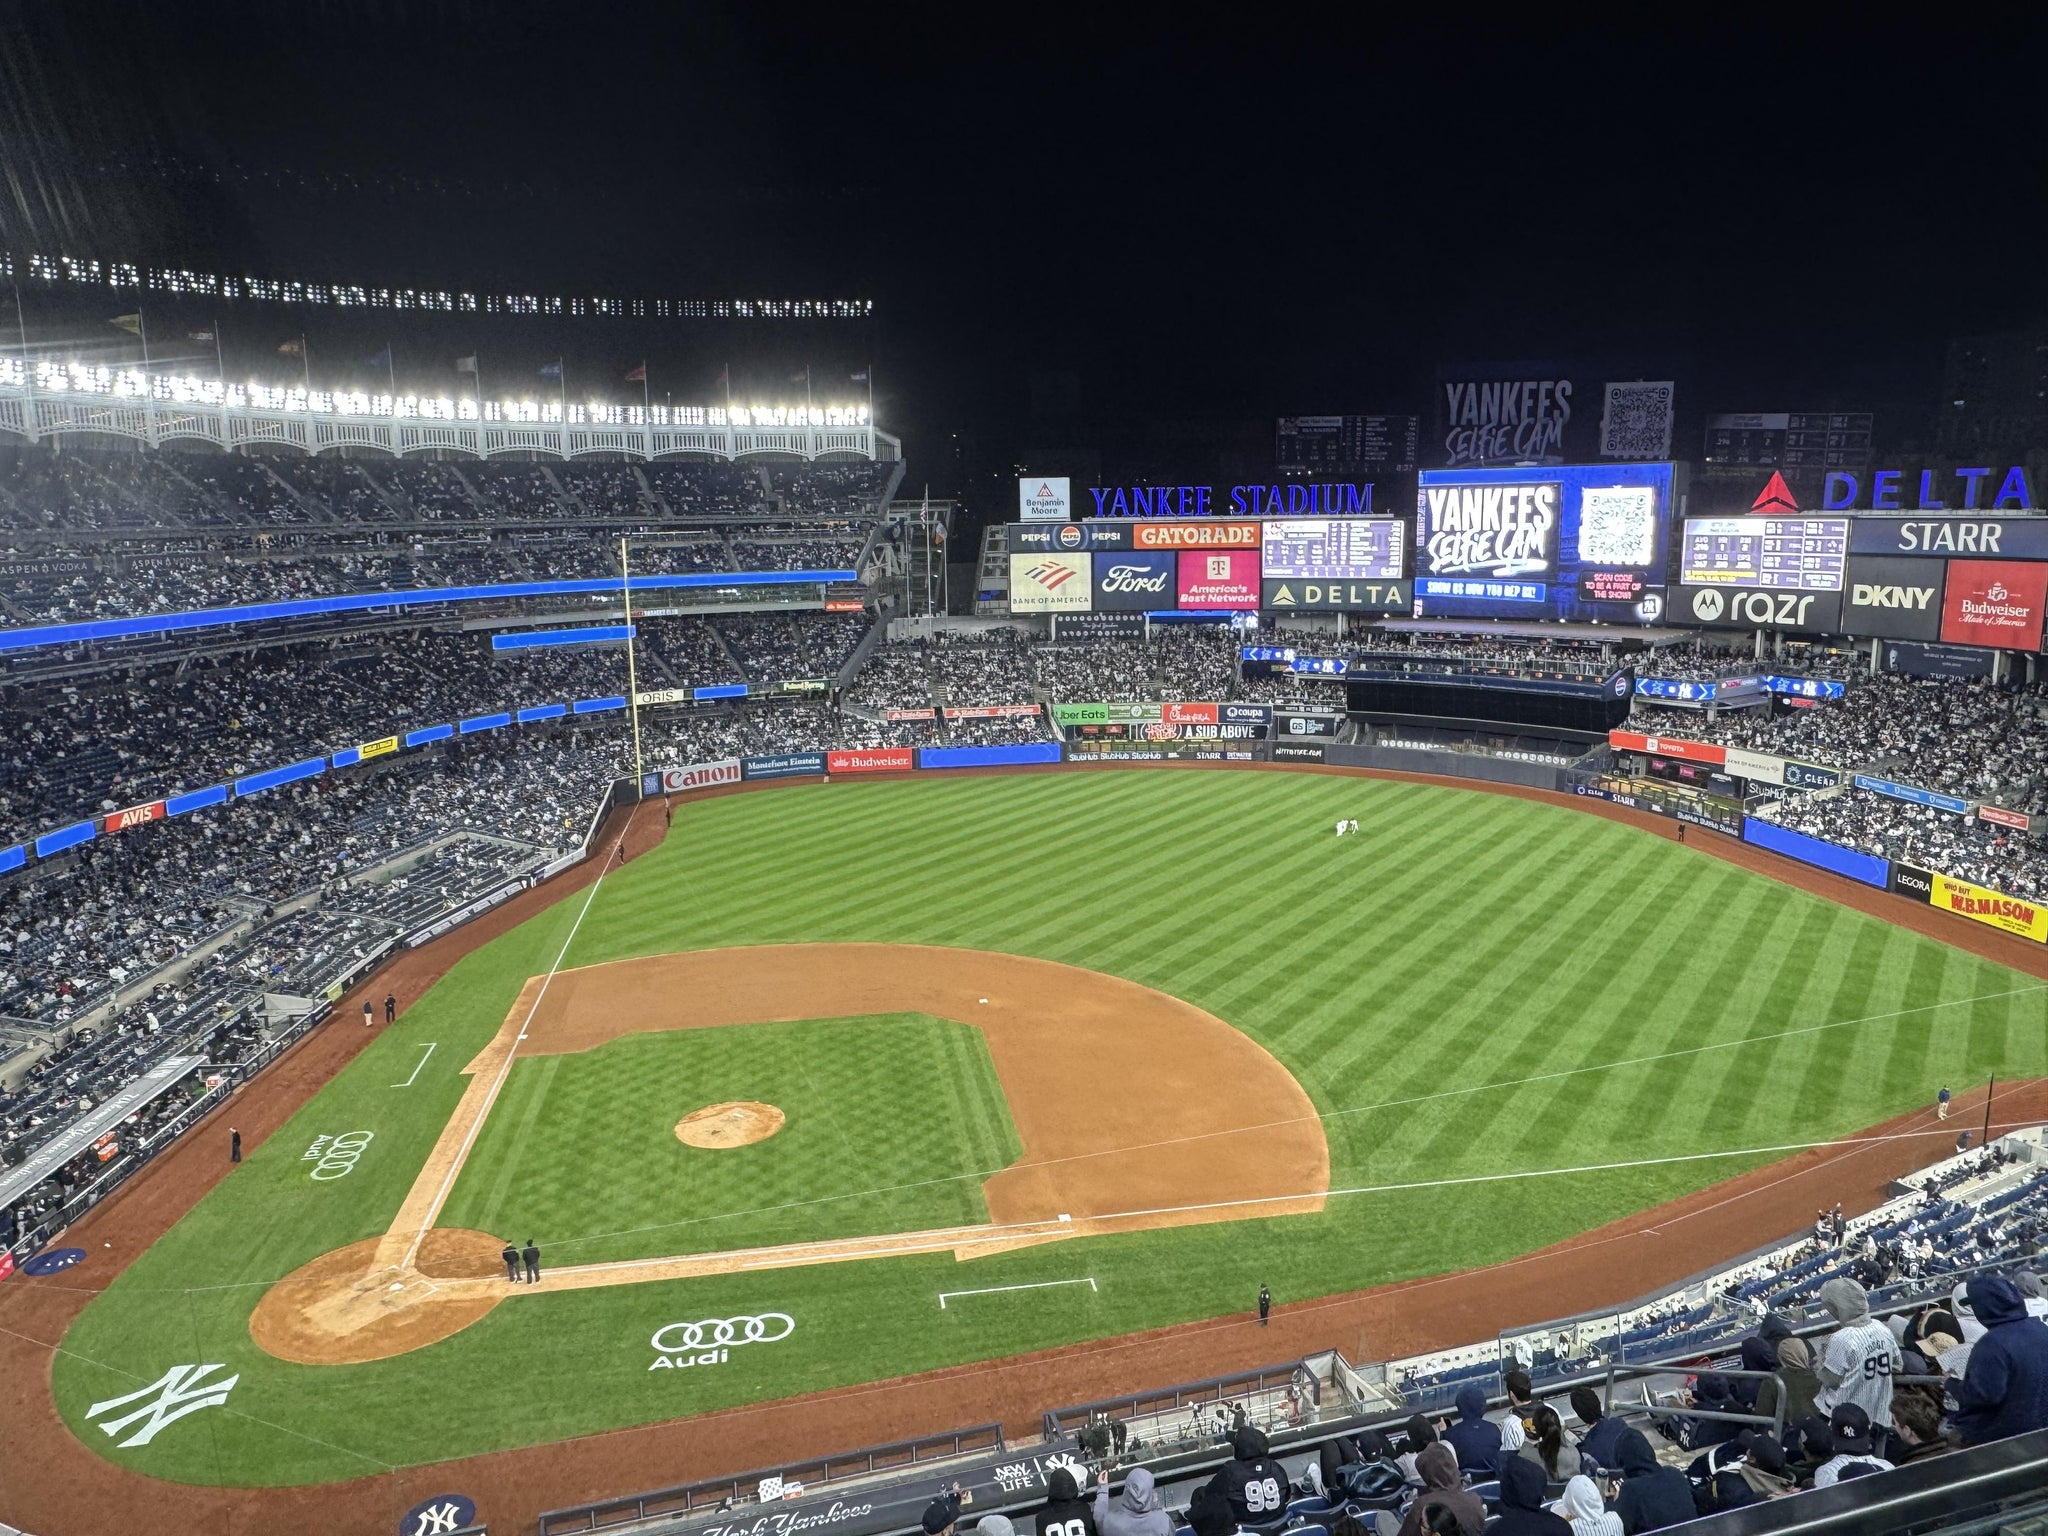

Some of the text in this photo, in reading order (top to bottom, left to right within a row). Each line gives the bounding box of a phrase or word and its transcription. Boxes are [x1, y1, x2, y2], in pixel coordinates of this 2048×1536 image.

[1446, 380, 1572, 425] YANKEES
[1822, 466, 2031, 511] DELTA
[1026, 498, 1065, 508] Benjamin
[1089, 483, 1375, 517] YANKEE STADIUM
[1427, 486, 1553, 531] YANKEES
[1021, 533, 1051, 542] PEPSI
[1092, 532, 1121, 541] PEPSI
[1141, 527, 1255, 544] GATORADE
[1898, 522, 2002, 552] STARR
[0, 562, 88, 575] ASPEN VODKA
[132, 559, 163, 568] ASPEN
[1101, 565, 1168, 592] Ford
[1594, 574, 1633, 582] SCAN CODE
[1189, 584, 1248, 594] America's
[1486, 584, 1502, 596] YOU
[1631, 583, 1642, 591] OF
[1050, 596, 1089, 604] AMERICA
[1180, 593, 1258, 603] Best Network
[1305, 585, 1403, 604] DELTA
[1594, 590, 1607, 598] THE
[1852, 584, 1935, 609] DKNY
[1731, 592, 1815, 625] razr
[1961, 599, 2029, 617] Budweiser
[1985, 616, 1994, 626] of
[642, 691, 674, 703] ORIS
[1082, 710, 1105, 719] Eats
[1238, 709, 1263, 718] coupa
[1186, 725, 1193, 738] A
[1196, 725, 1218, 738] SUB
[1220, 725, 1255, 738] ABOVE
[1659, 743, 1684, 752] TOYOTA
[851, 756, 909, 768] Budweiser
[1069, 753, 1098, 761] StubHub
[1100, 752, 1129, 760] StubHub
[1131, 752, 1161, 760] StubHub
[1196, 752, 1221, 760] STARR
[748, 759, 789, 770] Montefiore
[790, 757, 820, 766] Einstein
[665, 765, 739, 789] Canon
[1804, 773, 1835, 786] CLEAR
[1612, 794, 1635, 807] STARR
[119, 807, 153, 828] AVIS
[1944, 883, 1971, 896] WHO BUT
[300, 1134, 333, 1160] Audi
[648, 1349, 728, 1371] Audi
[1864, 1351, 1891, 1380] 99
[1000, 1475, 1034, 1492] LIFE
[1244, 1477, 1280, 1512] 99
[770, 1501, 873, 1536] Yankees
